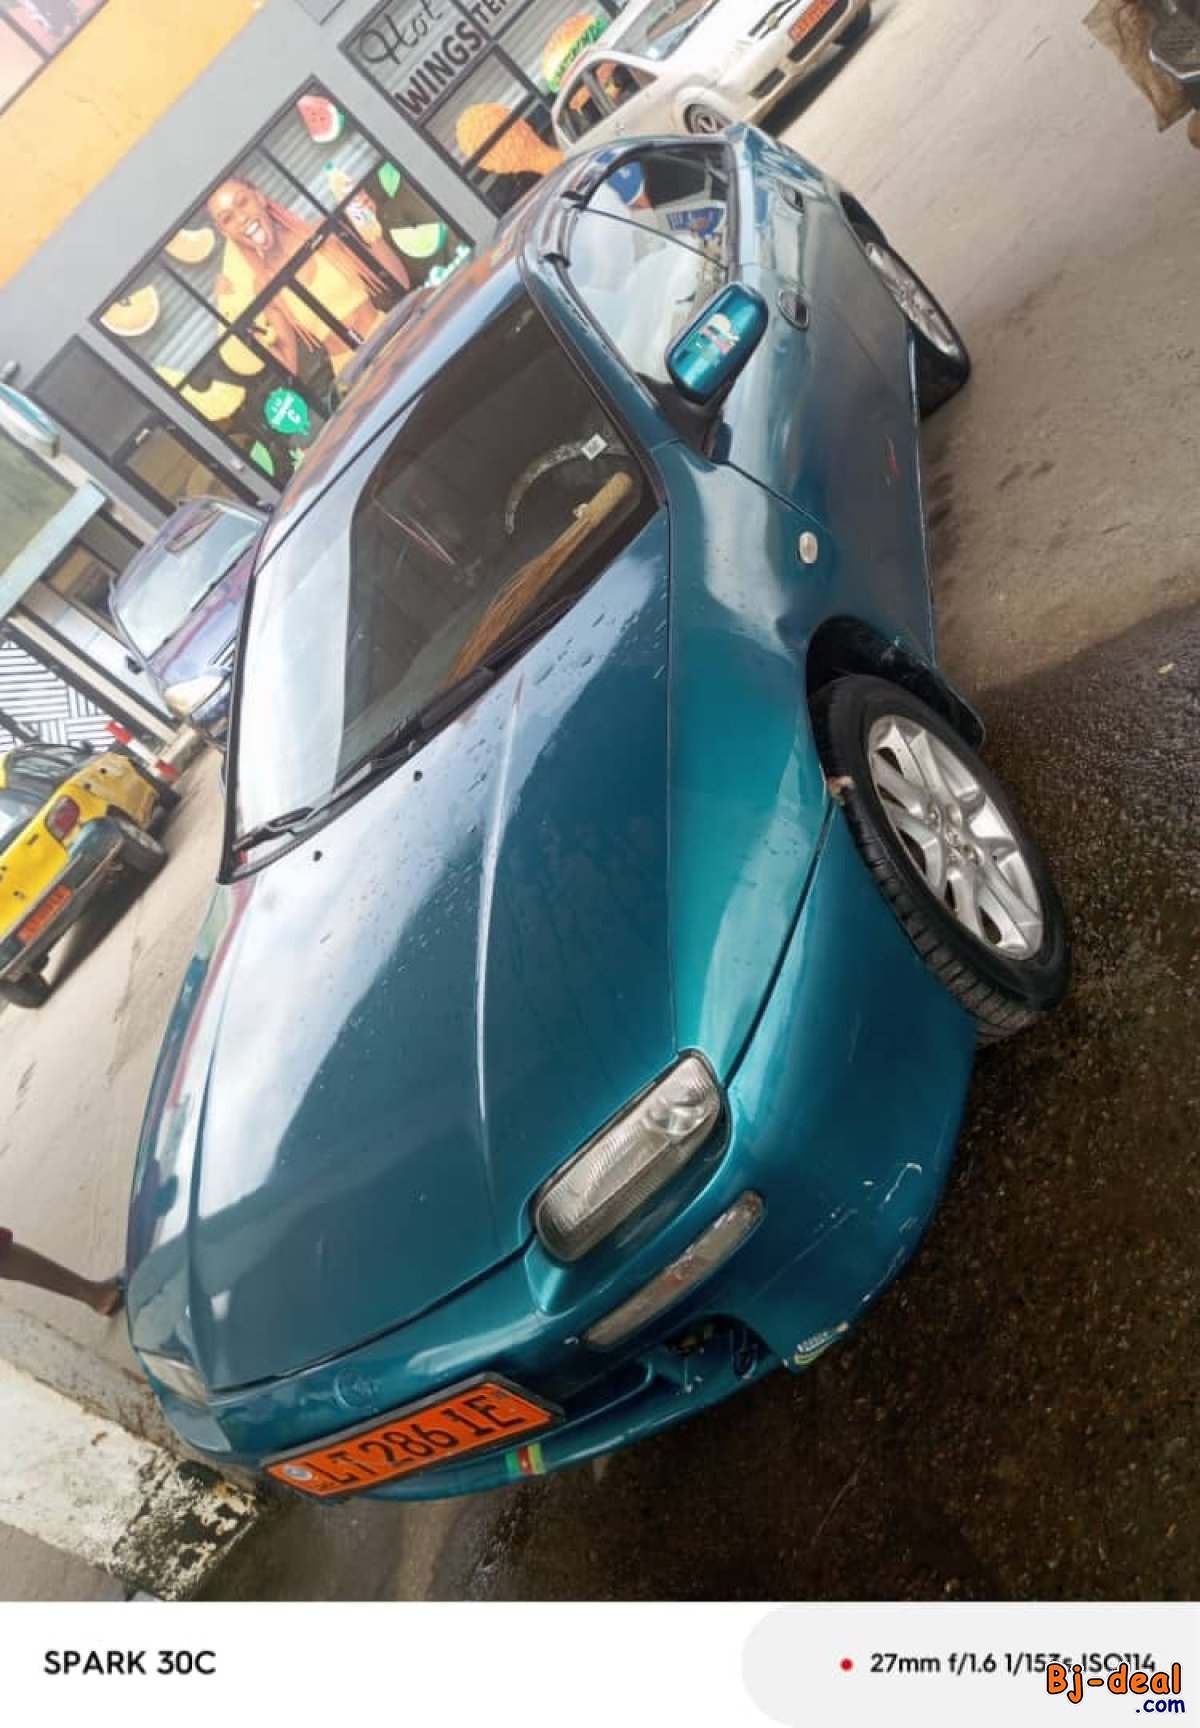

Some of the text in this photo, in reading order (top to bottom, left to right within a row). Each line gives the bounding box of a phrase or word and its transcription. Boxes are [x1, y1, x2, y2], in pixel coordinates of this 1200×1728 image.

[359, 0, 442, 64] Hot
[394, 0, 507, 115] WINGS TE
[303, 1450, 376, 1484] LT
[358, 1423, 460, 1467] 286
